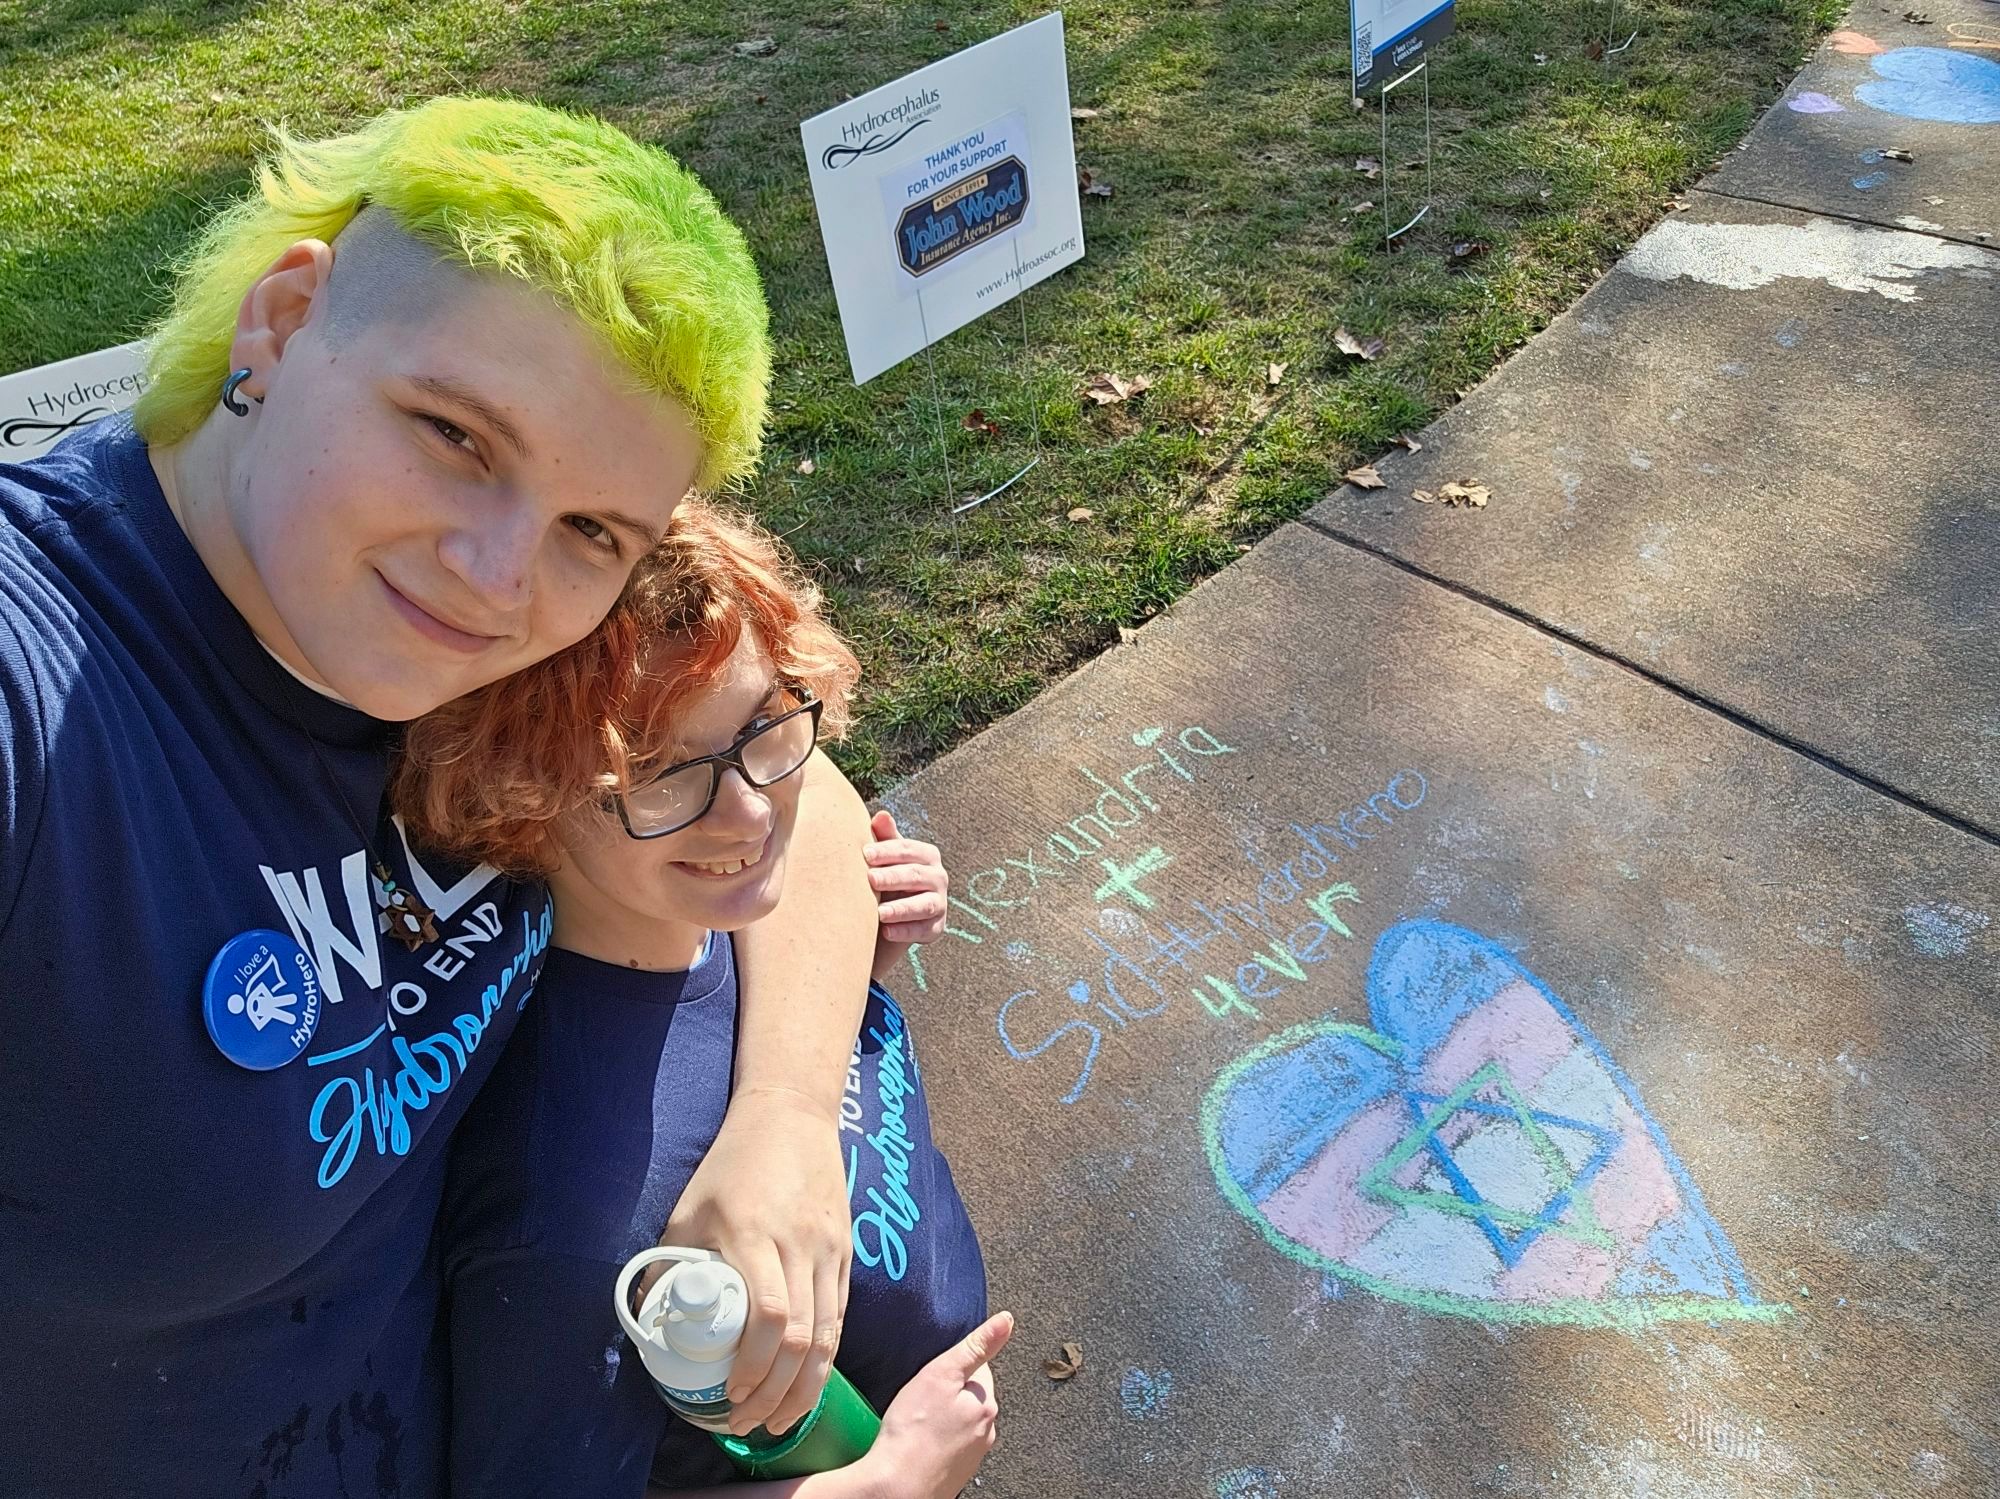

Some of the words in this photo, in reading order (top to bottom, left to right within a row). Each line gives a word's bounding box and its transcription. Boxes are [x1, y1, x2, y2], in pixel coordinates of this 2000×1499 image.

[842, 88, 940, 142] Hydrocephalus
[905, 103, 942, 125] Association
[907, 179, 930, 198] FOR
[930, 163, 960, 184] YOUR
[959, 139, 1008, 171] SUPPORT
[924, 142, 962, 170] THANK
[961, 131, 986, 152] YOU
[905, 214, 960, 266] John
[957, 172, 1023, 227] Wood
[940, 187, 964, 204] SINCE
[920, 237, 961, 266] Insurance
[962, 219, 993, 244] Agency
[995, 212, 1013, 226] Inc.
[976, 237, 1076, 299] www.Hydroassoc.org
[238, 952, 263, 979] love
[259, 944, 269, 956] a
[423, 902, 503, 982] END
[1192, 880, 1364, 1021] 4ever
[233, 974, 244, 985] I
[290, 953, 318, 1049] HydroHero
[839, 1095, 864, 1135] TO
